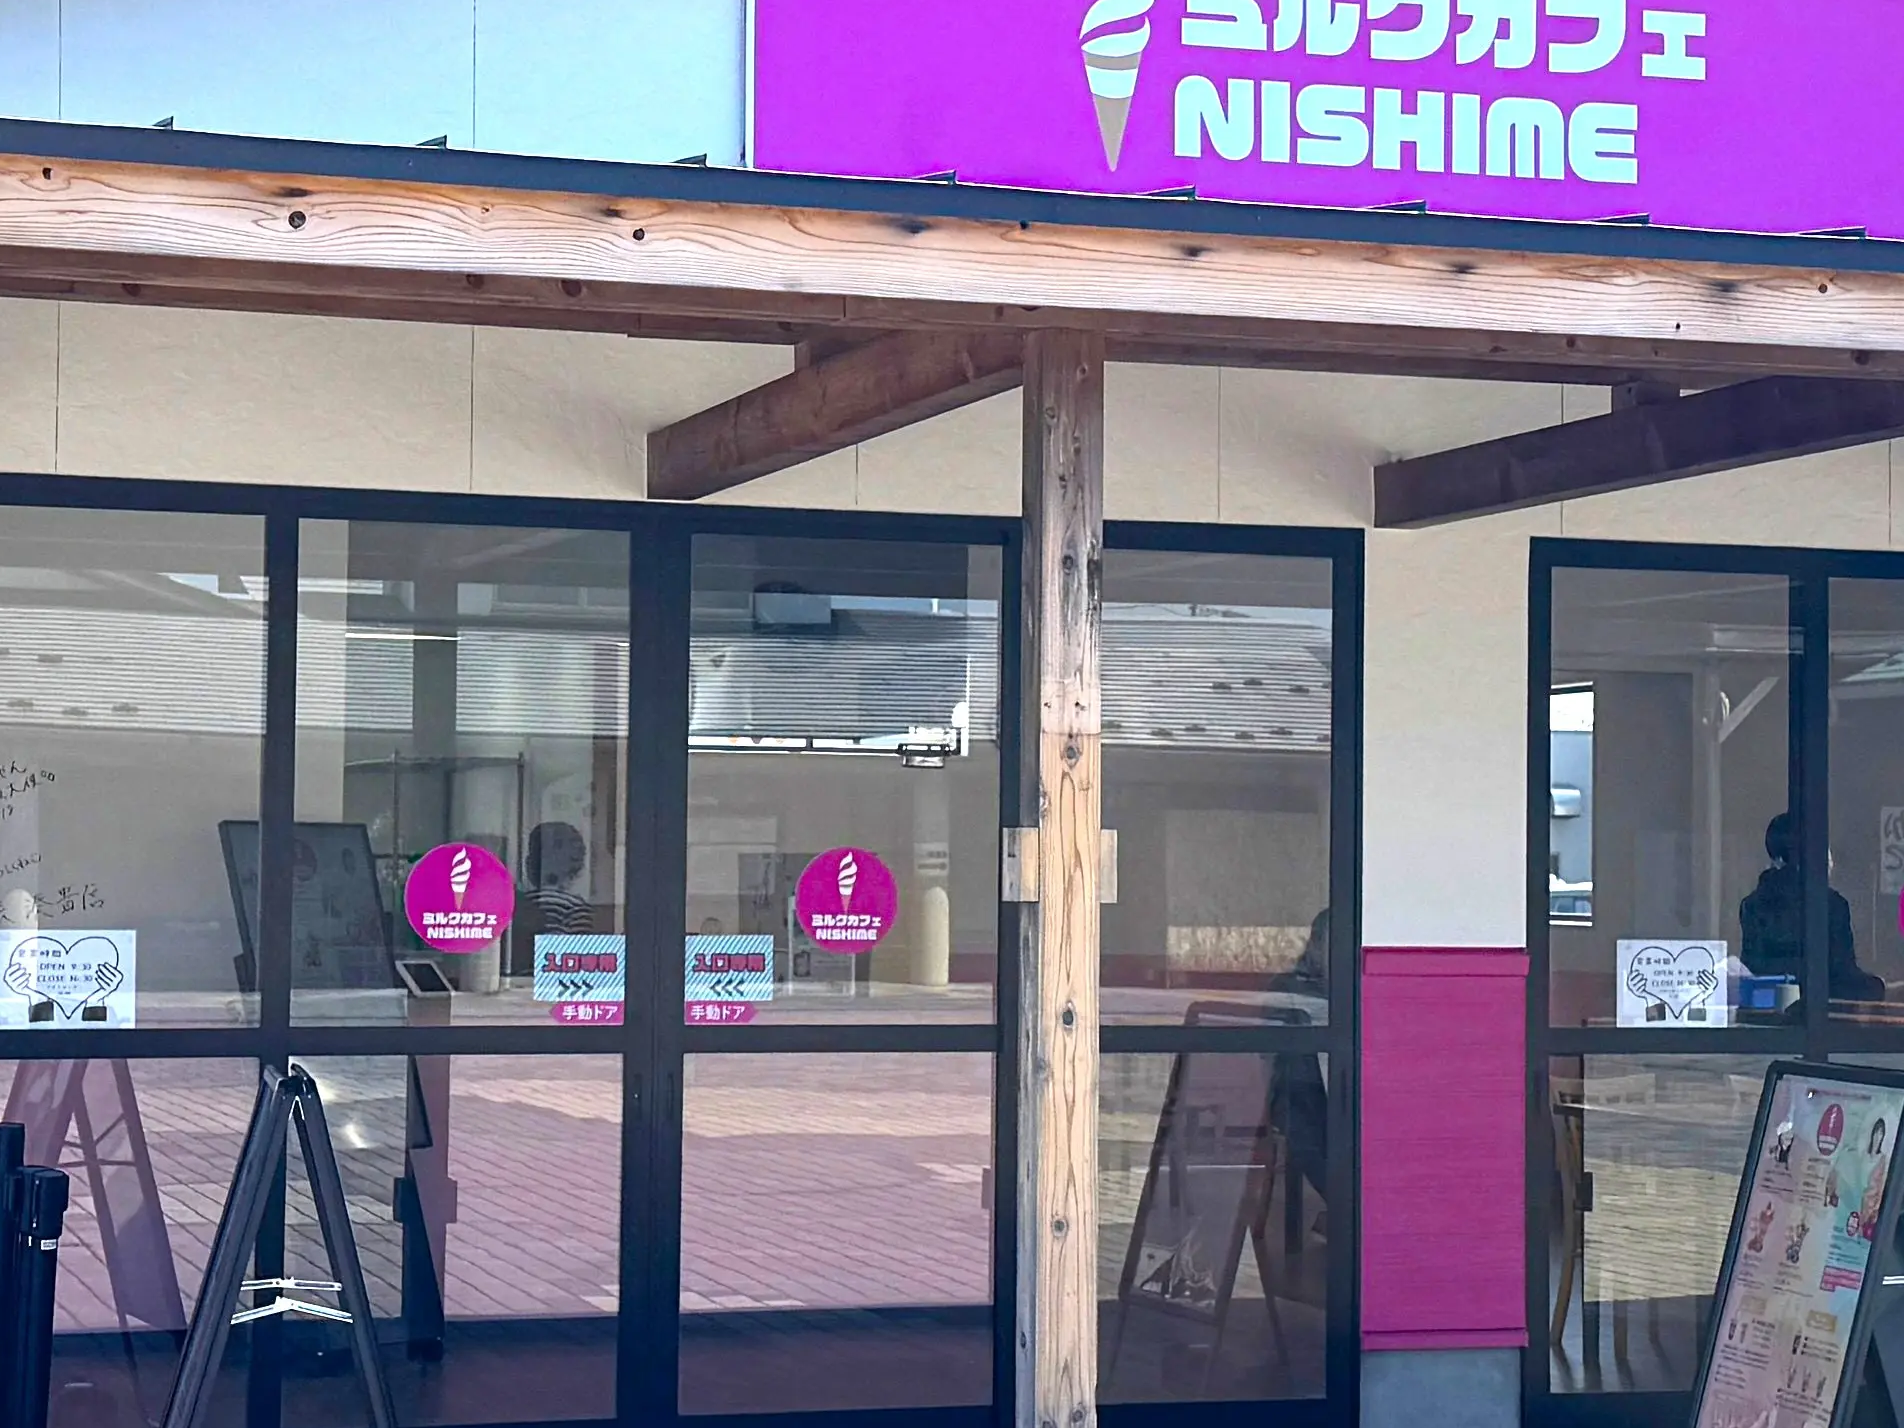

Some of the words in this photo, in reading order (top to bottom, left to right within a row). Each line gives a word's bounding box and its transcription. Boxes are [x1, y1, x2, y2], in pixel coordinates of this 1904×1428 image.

[1173, 74, 1640, 185] NISHIME
[422, 912, 498, 925] ミルクカフェ
[811, 914, 882, 927] ミルクカフェ
[427, 926, 493, 939] NISHIME
[816, 929, 877, 940] NISHIME
[562, 1004, 618, 1021] 手動ドア
[691, 1005, 745, 1021] 手動ドア
